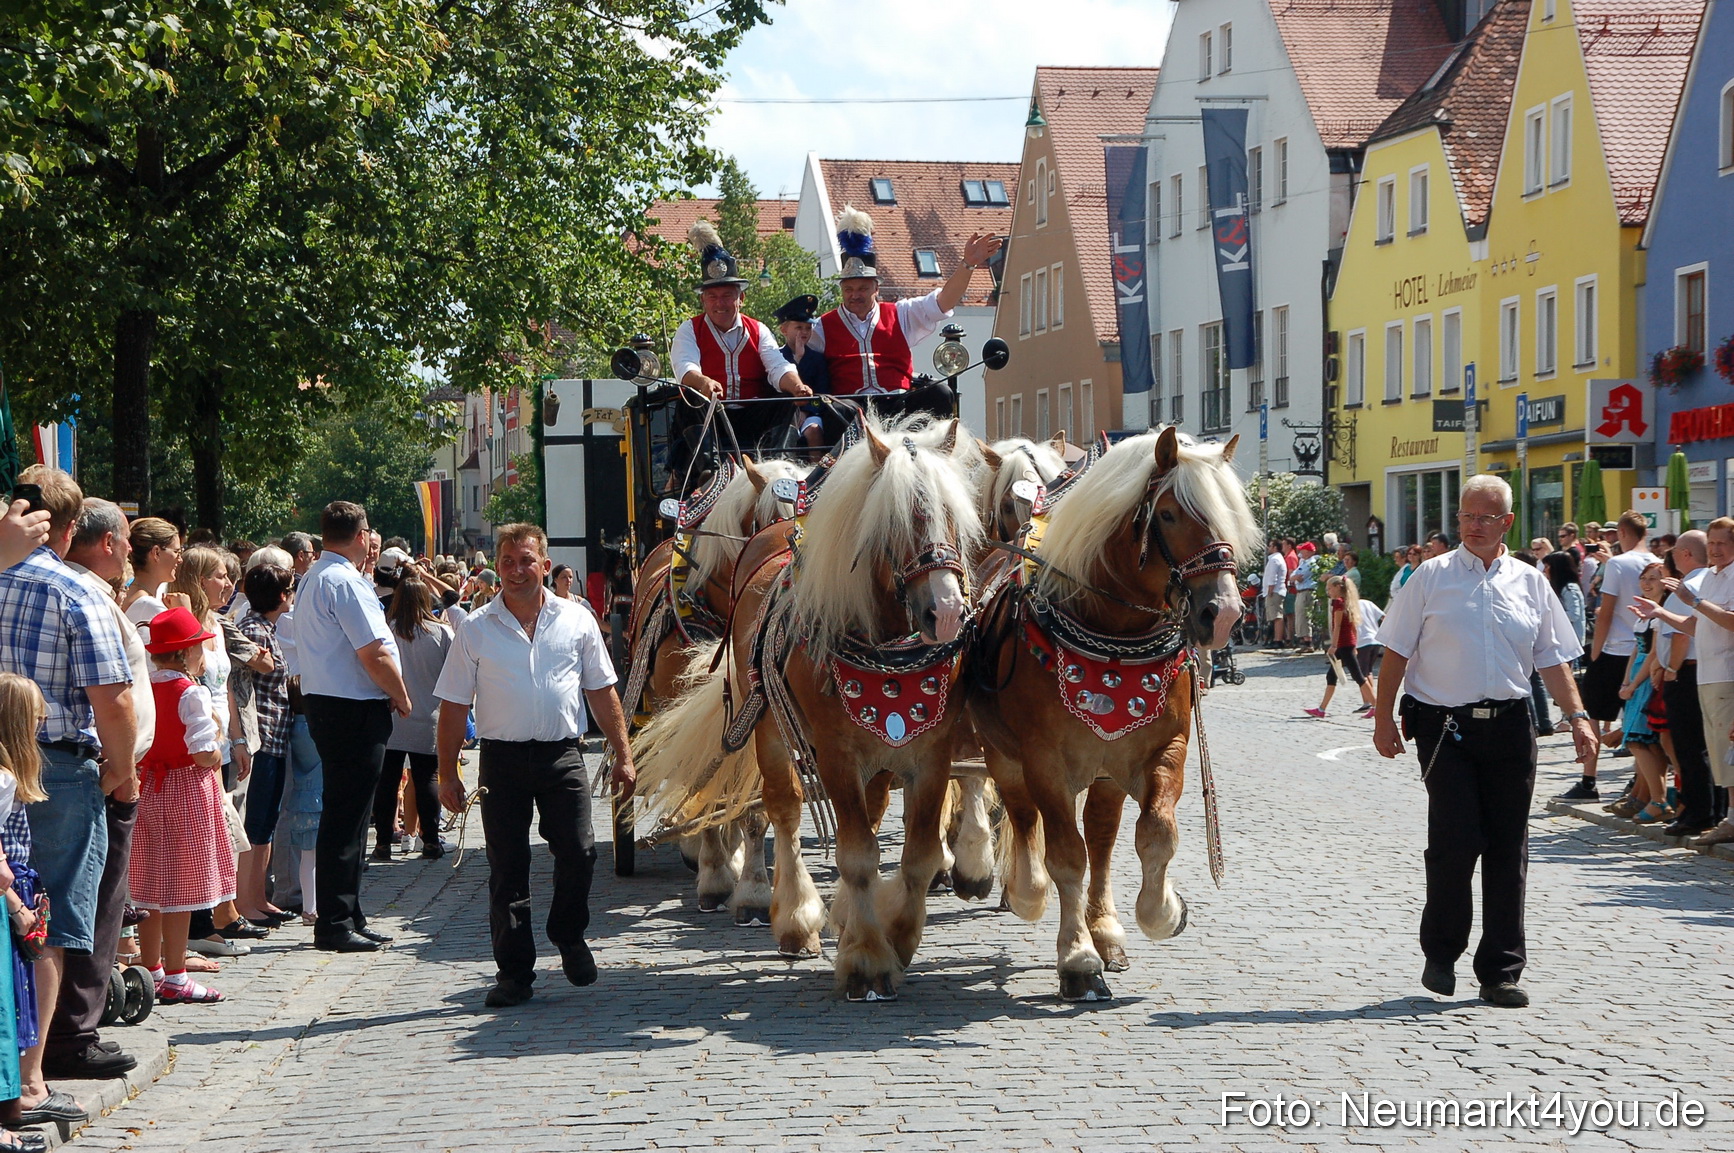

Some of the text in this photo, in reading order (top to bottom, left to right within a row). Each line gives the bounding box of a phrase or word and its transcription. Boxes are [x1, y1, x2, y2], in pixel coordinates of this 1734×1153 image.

[1394, 267, 1478, 310] HOTEL Lehmeier
[1518, 400, 1526, 434] P
[1526, 400, 1556, 422] AIFUN
[1390, 435, 1439, 458] Restaurant
